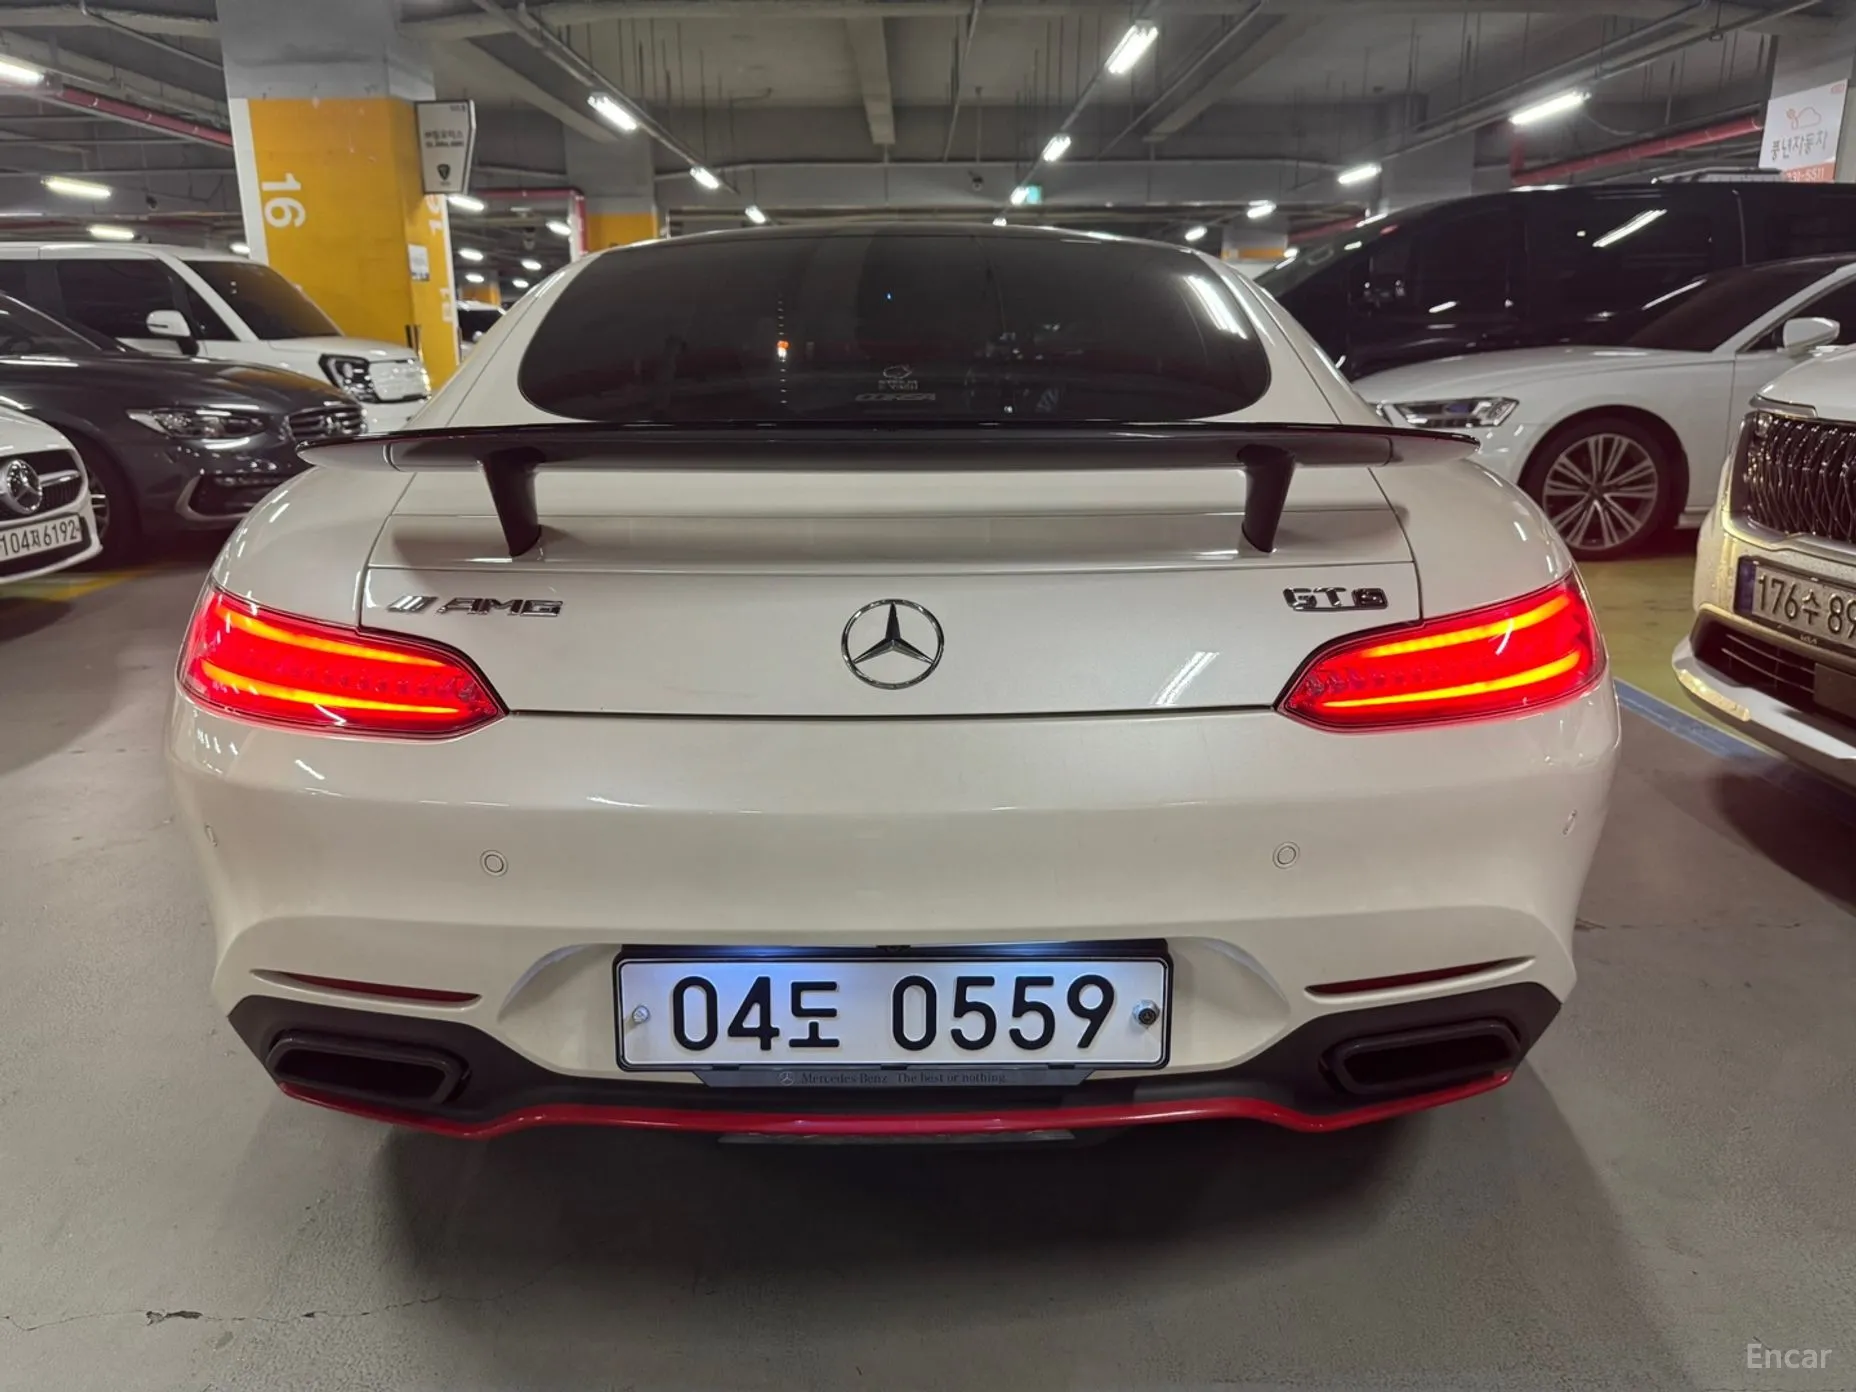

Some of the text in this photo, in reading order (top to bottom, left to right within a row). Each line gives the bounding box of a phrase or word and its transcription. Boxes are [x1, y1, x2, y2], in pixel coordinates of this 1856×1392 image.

[261, 173, 307, 228] 16
[436, 597, 563, 618] AMG
[672, 975, 1115, 1051] 04도 0559
[898, 1072, 917, 1084] The
[920, 1072, 944, 1084] best
[947, 1074, 959, 1084] or
